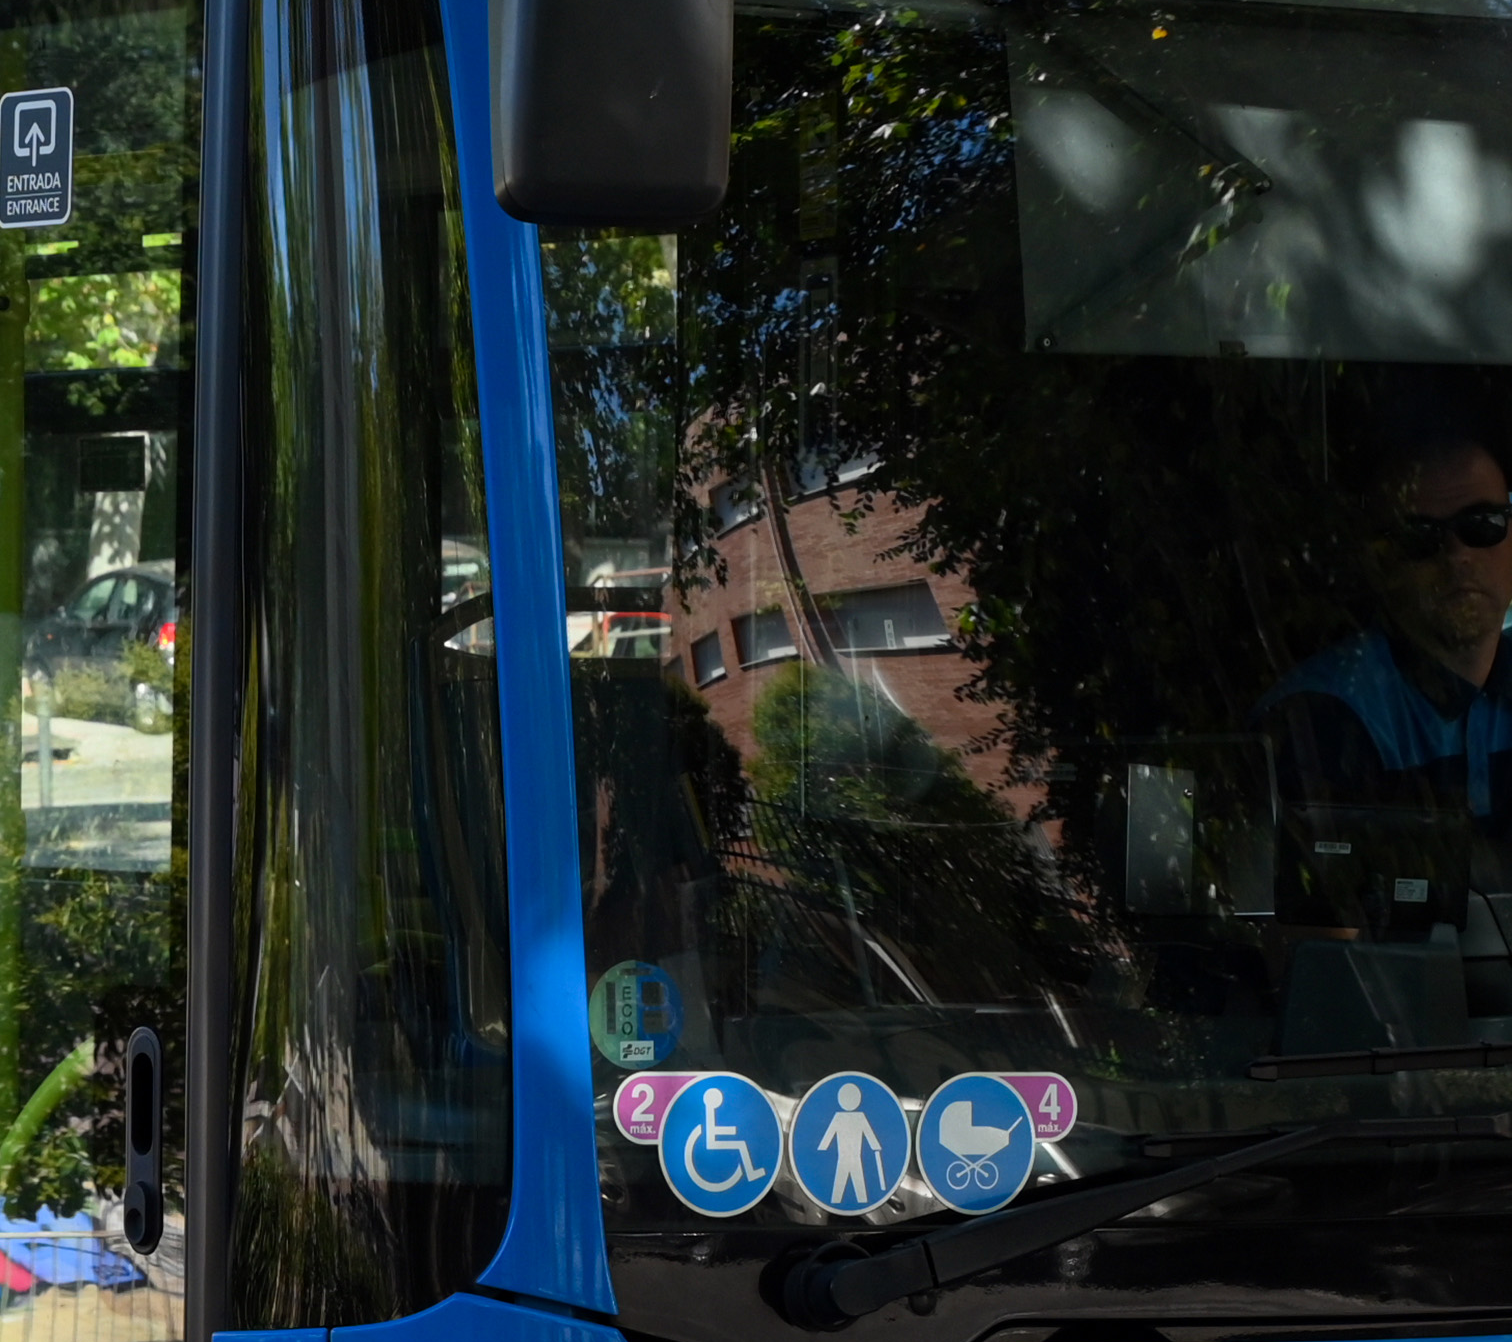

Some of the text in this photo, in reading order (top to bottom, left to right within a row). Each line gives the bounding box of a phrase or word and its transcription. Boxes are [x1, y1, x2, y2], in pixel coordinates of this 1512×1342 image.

[7, 171, 62, 193] ENTRADA
[6, 197, 60, 216] ENTRANCE
[621, 985, 633, 1036] ECO
[629, 1083, 656, 1123] 2
[1038, 1082, 1063, 1122] 4
[629, 1120, 658, 1136] máx.
[1037, 1119, 1063, 1134] máx.
